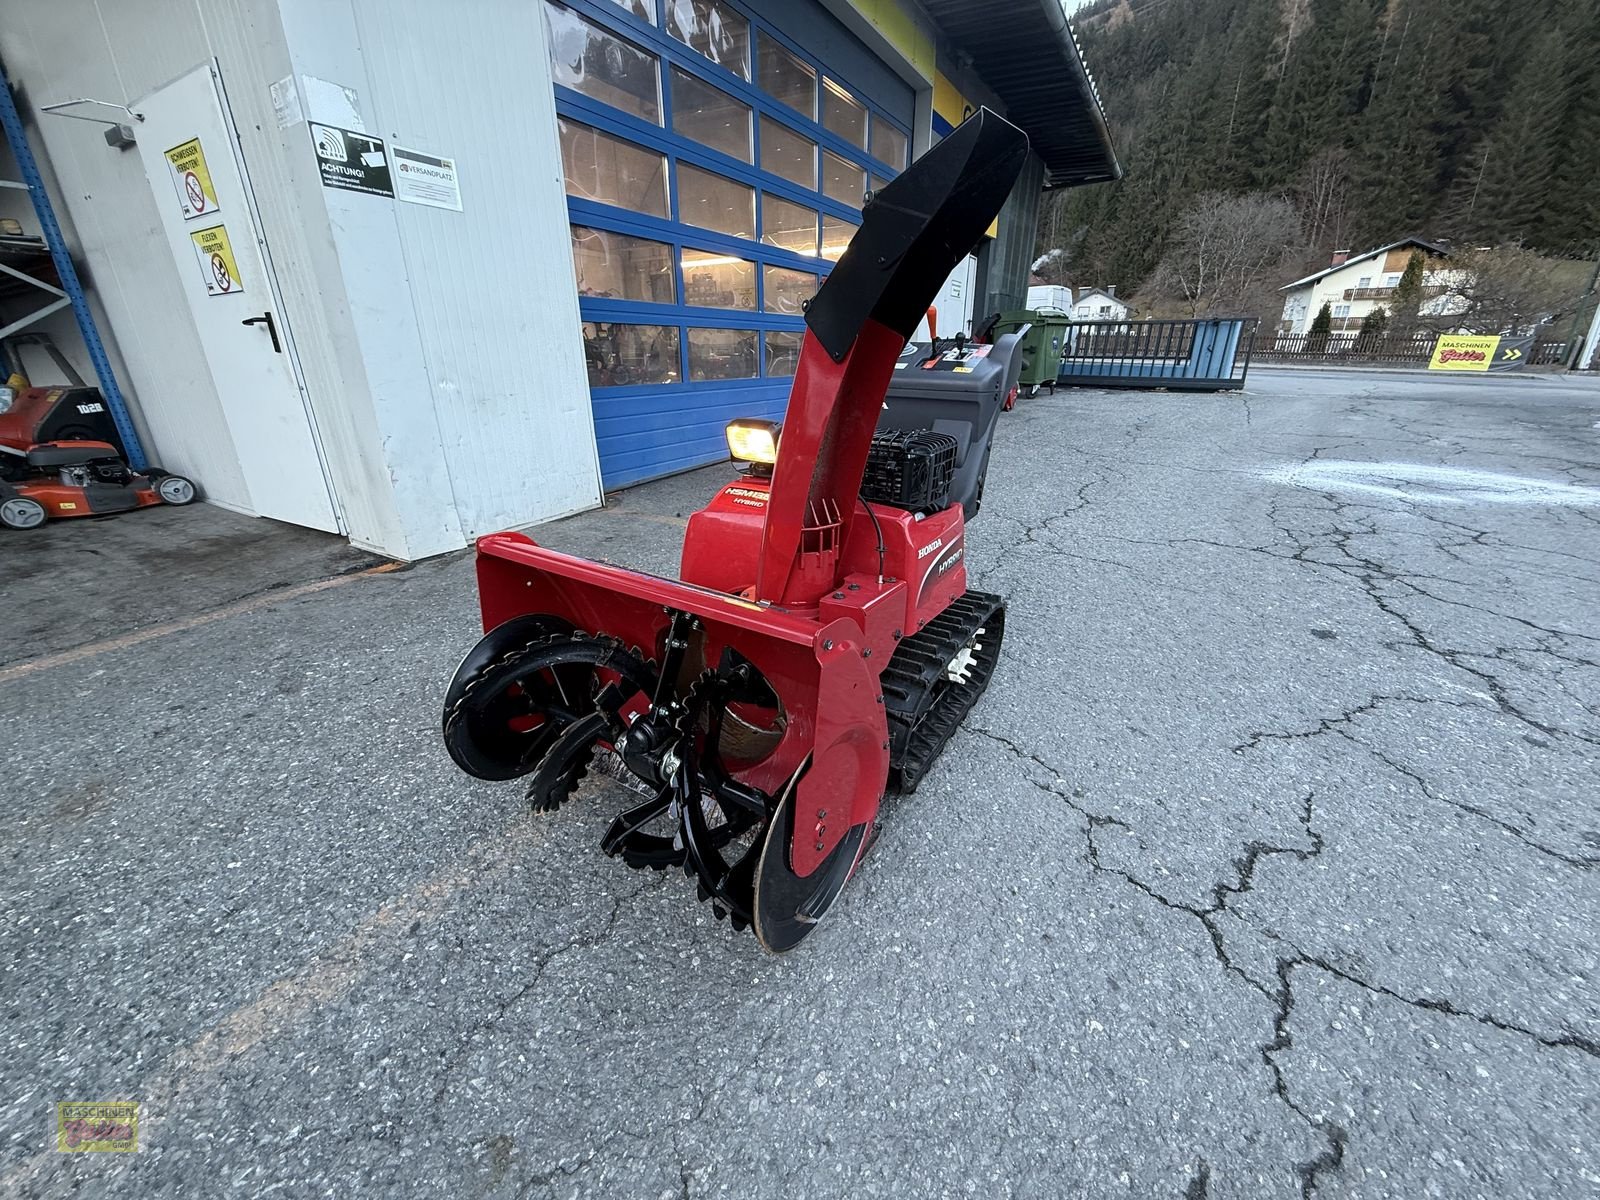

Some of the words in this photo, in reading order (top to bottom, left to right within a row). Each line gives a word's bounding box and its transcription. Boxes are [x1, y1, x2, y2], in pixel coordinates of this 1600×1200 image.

[321, 162, 365, 178] ACHTUNG!
[408, 166, 453, 182] VERSANDPLATZ
[76, 403, 104, 414] 1028
[733, 498, 764, 508] HYBRID
[918, 538, 942, 560] HONDA
